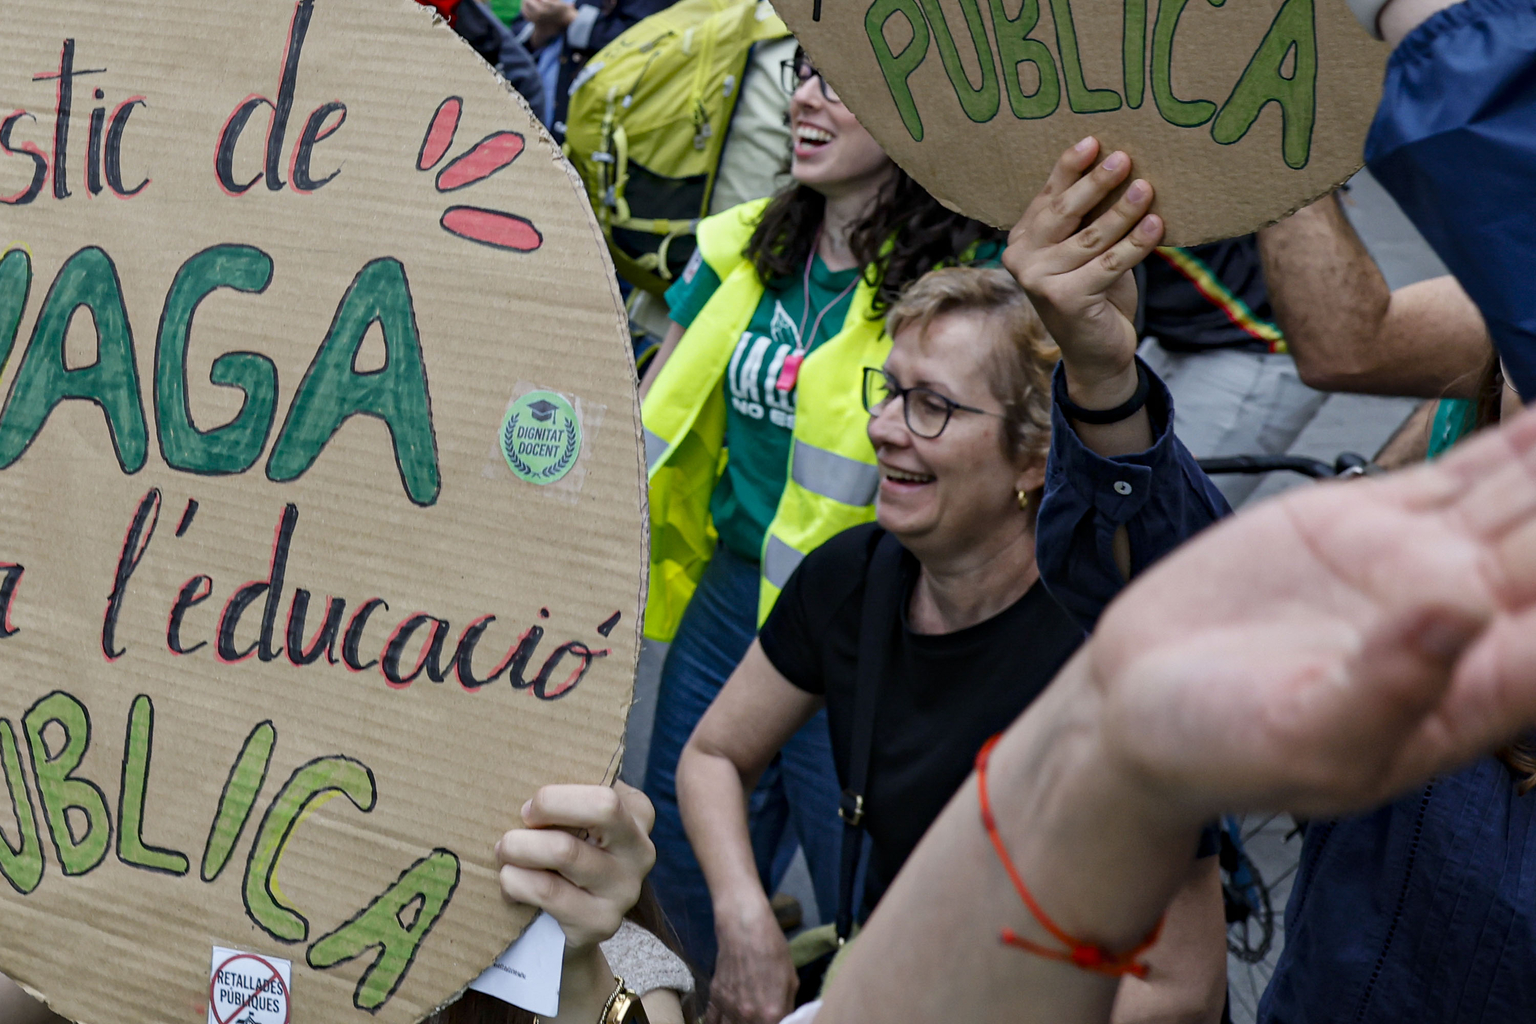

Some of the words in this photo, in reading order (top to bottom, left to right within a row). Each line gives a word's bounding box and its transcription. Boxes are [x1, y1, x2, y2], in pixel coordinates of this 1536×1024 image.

[517, 425, 564, 443] DIGNITAT
[518, 441, 560, 458] DOCENT
[100, 487, 611, 701] l'educació
[217, 969, 284, 996] RETALLADES
[220, 986, 280, 1013] PÚBLIQUES
